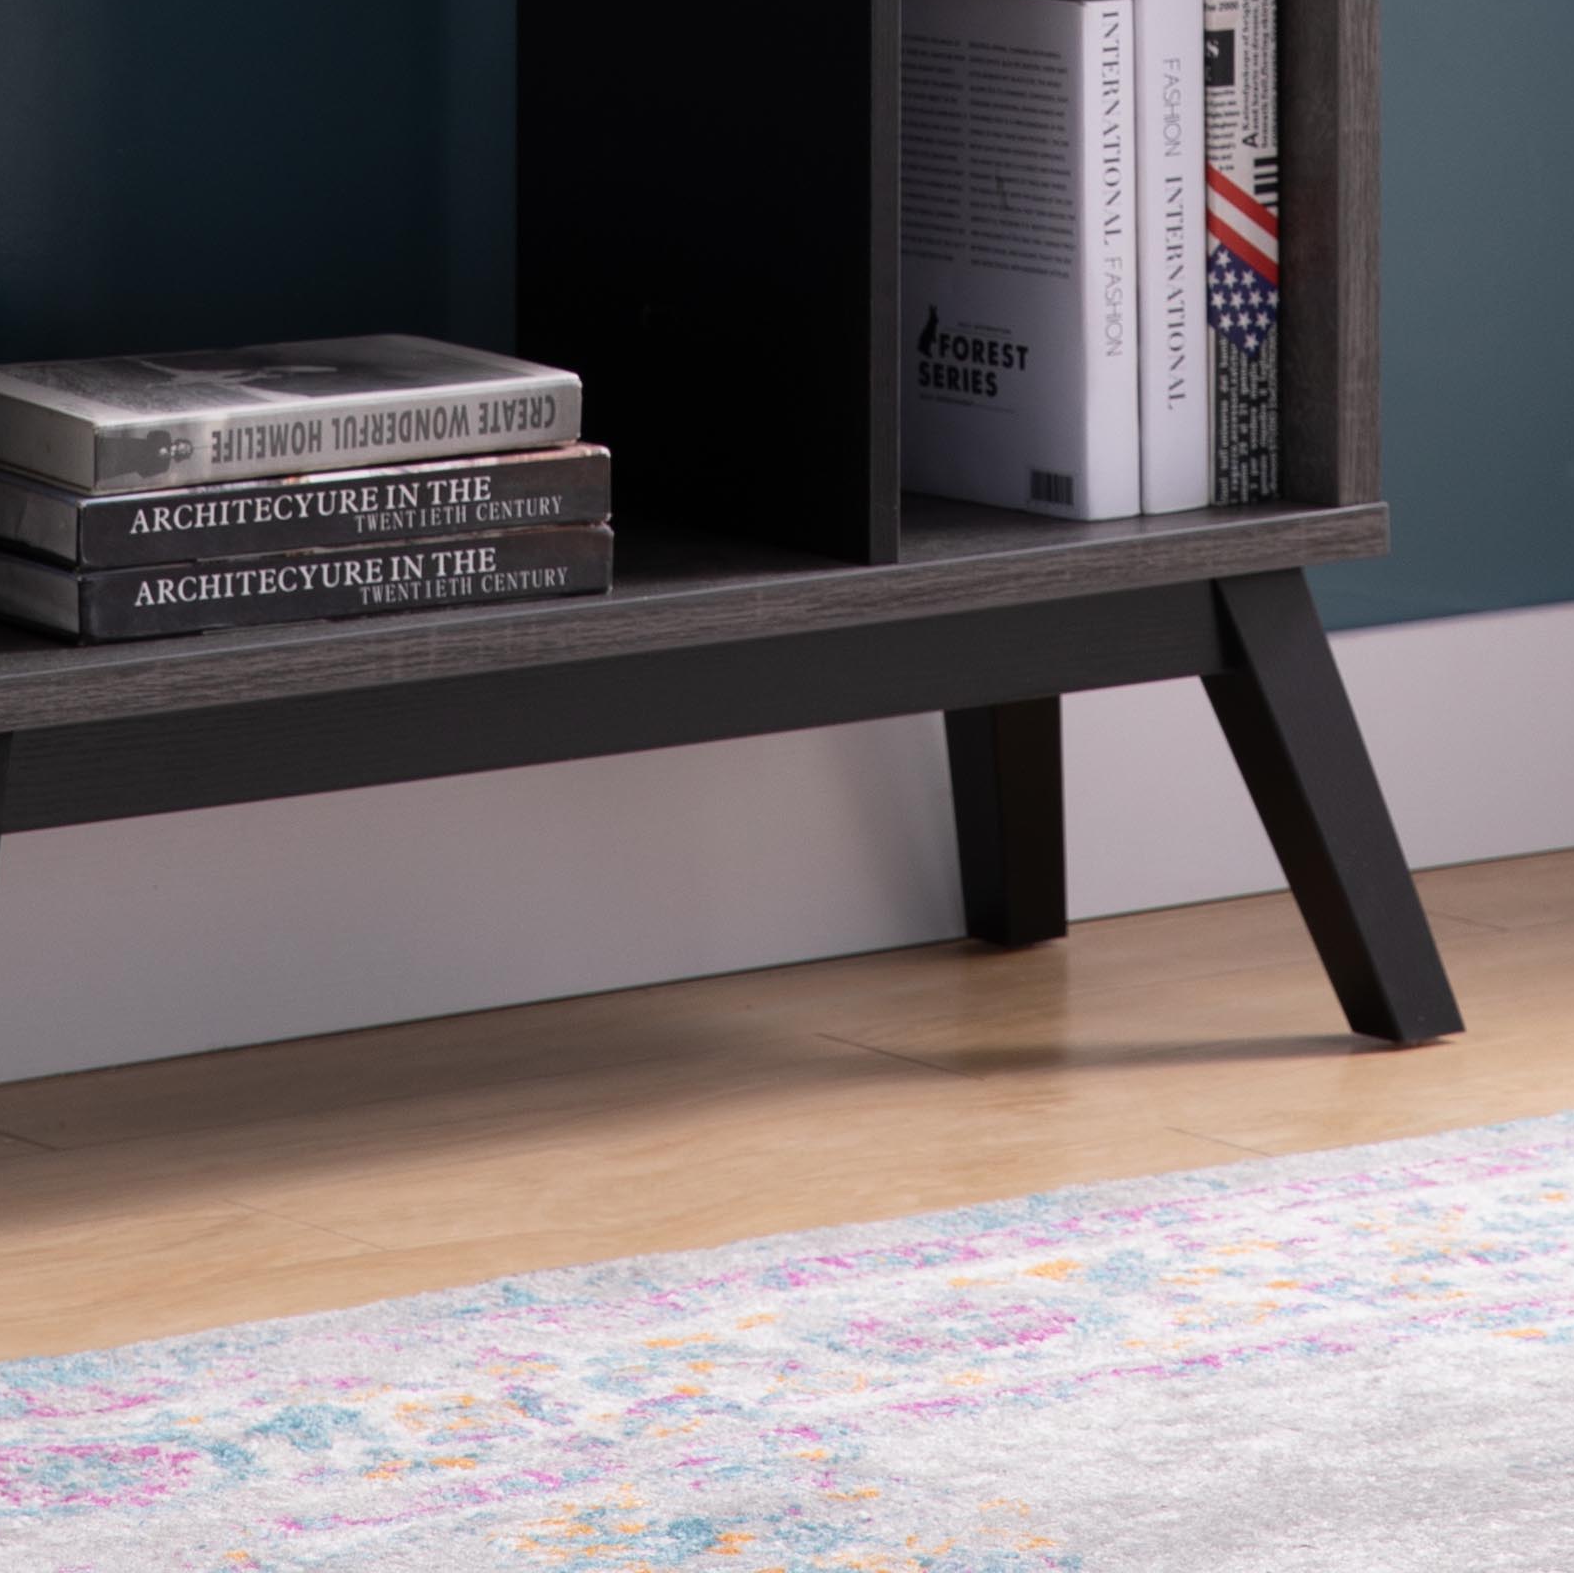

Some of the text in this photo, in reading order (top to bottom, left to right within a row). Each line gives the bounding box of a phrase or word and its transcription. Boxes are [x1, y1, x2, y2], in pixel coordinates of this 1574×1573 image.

[1102, 12, 1123, 357] INTERNATIONAL FASHION
[1163, 58, 1187, 410] FASHION INTERNATIONAL
[918, 360, 998, 397] SERIES
[938, 332, 1029, 371] FOREST
[211, 394, 556, 463] CREATE WONDERFUL HOMELIFE
[130, 476, 492, 534] ARCHITECYURE IN THE
[476, 495, 563, 522] CENTURY
[135, 547, 497, 607] ARCHITECYURE IN THE
[481, 567, 568, 594] CENTURY
